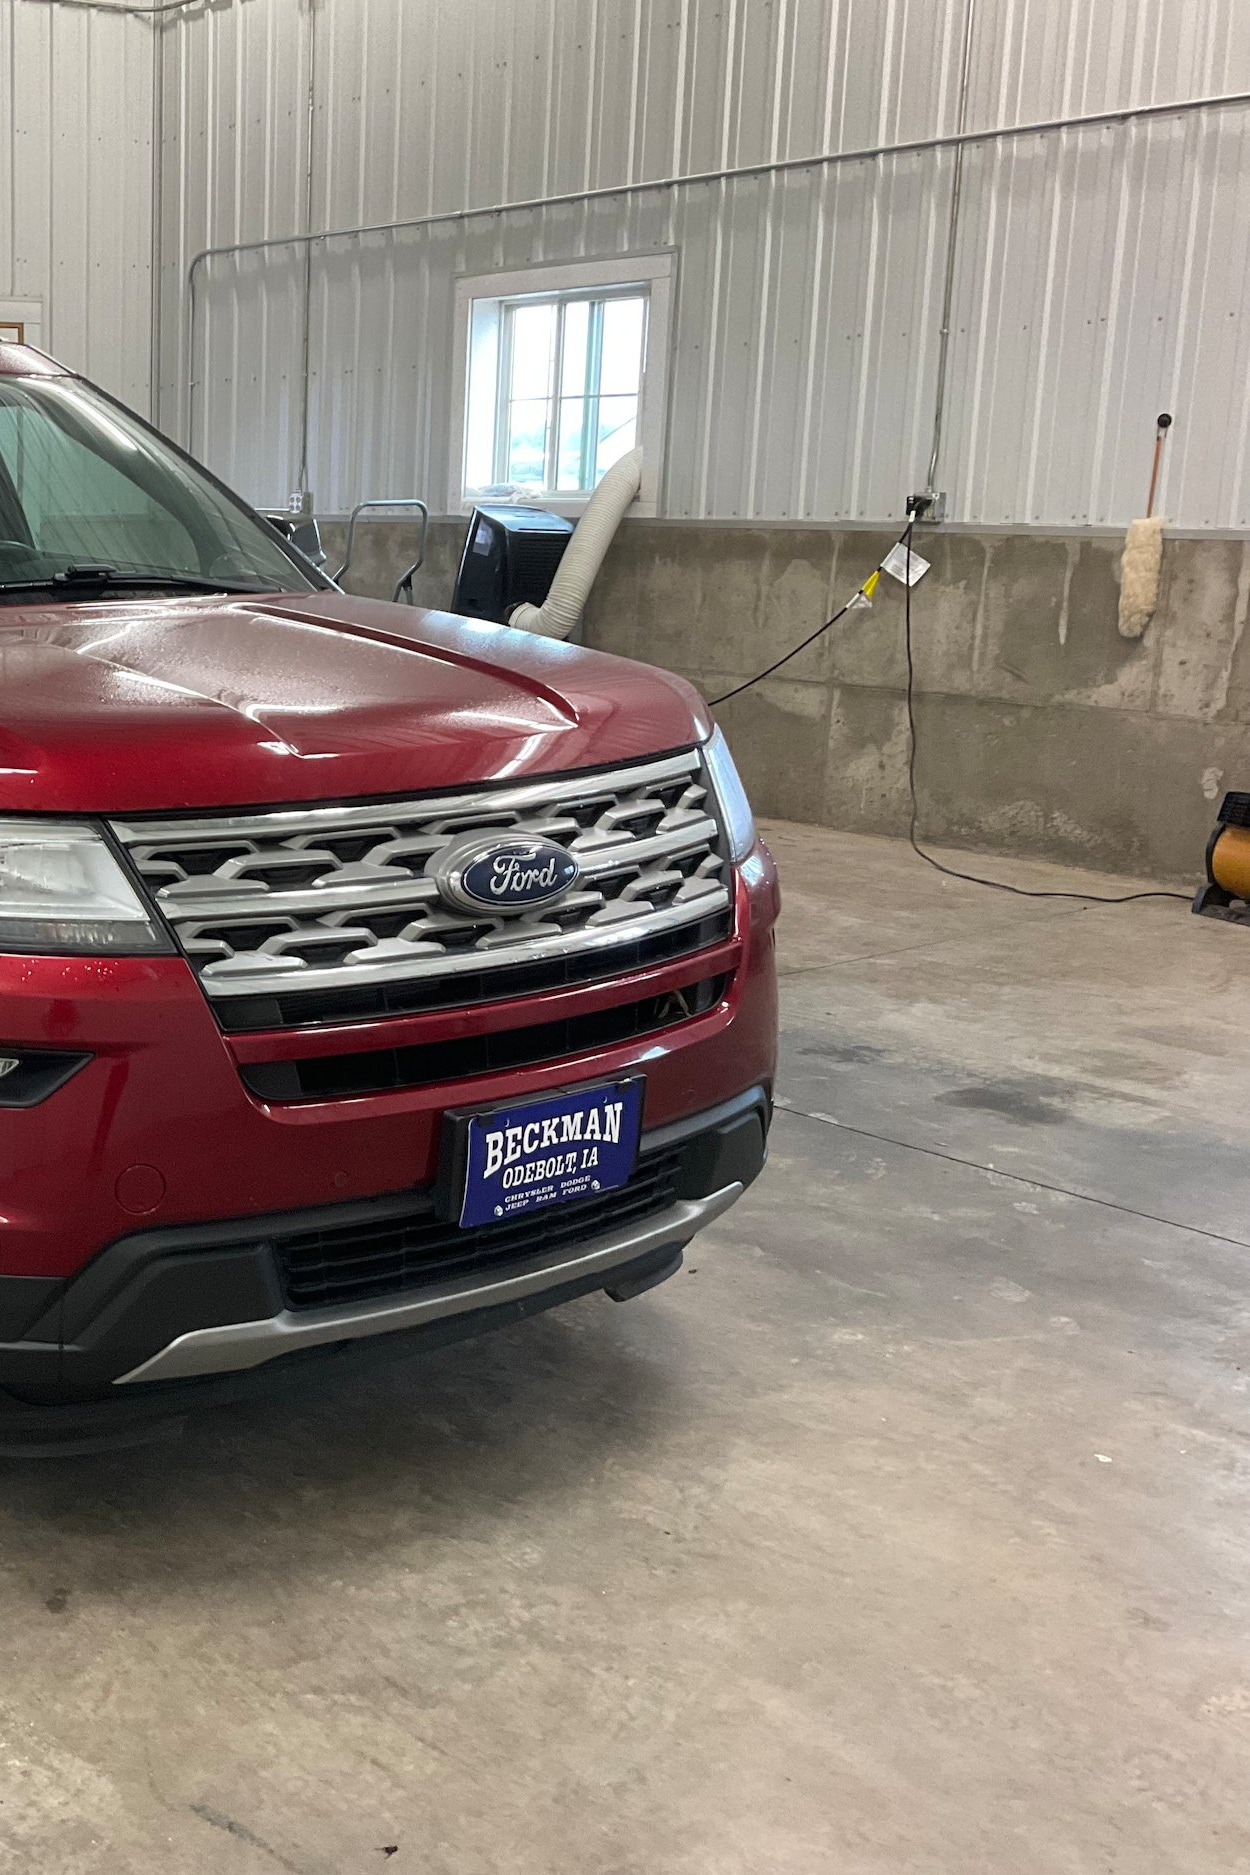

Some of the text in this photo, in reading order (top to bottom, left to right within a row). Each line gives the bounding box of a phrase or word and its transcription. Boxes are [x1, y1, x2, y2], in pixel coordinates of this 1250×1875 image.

[490, 852, 558, 895] Ford
[483, 1102, 623, 1179] BECKMAN
[502, 1146, 599, 1189] ODEBOLT, IA
[505, 1175, 591, 1203] CHRYSLER DODGE
[505, 1184, 587, 1211] JEEP RAM FORD
